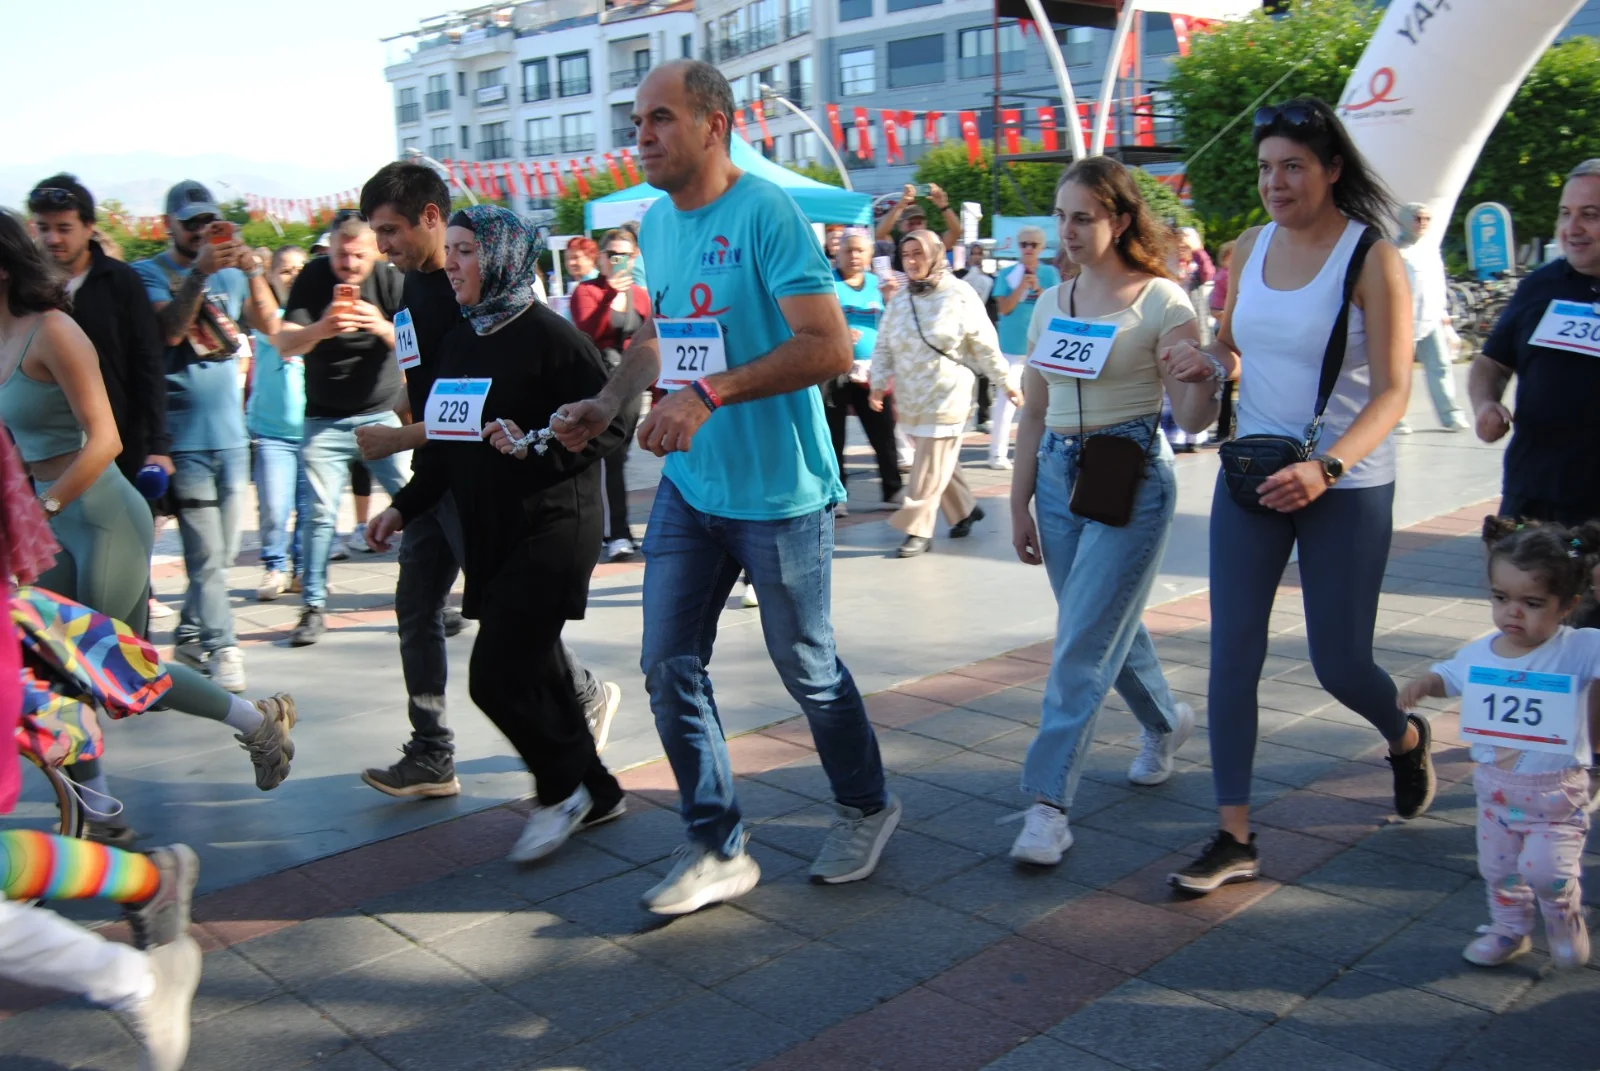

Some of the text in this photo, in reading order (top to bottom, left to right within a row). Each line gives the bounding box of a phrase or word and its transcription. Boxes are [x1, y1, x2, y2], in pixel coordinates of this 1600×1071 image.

[398, 330, 411, 352] 114
[1051, 339, 1094, 362] 226
[676, 346, 708, 371] 227
[438, 401, 469, 423] 229
[1483, 693, 1542, 726] 125
